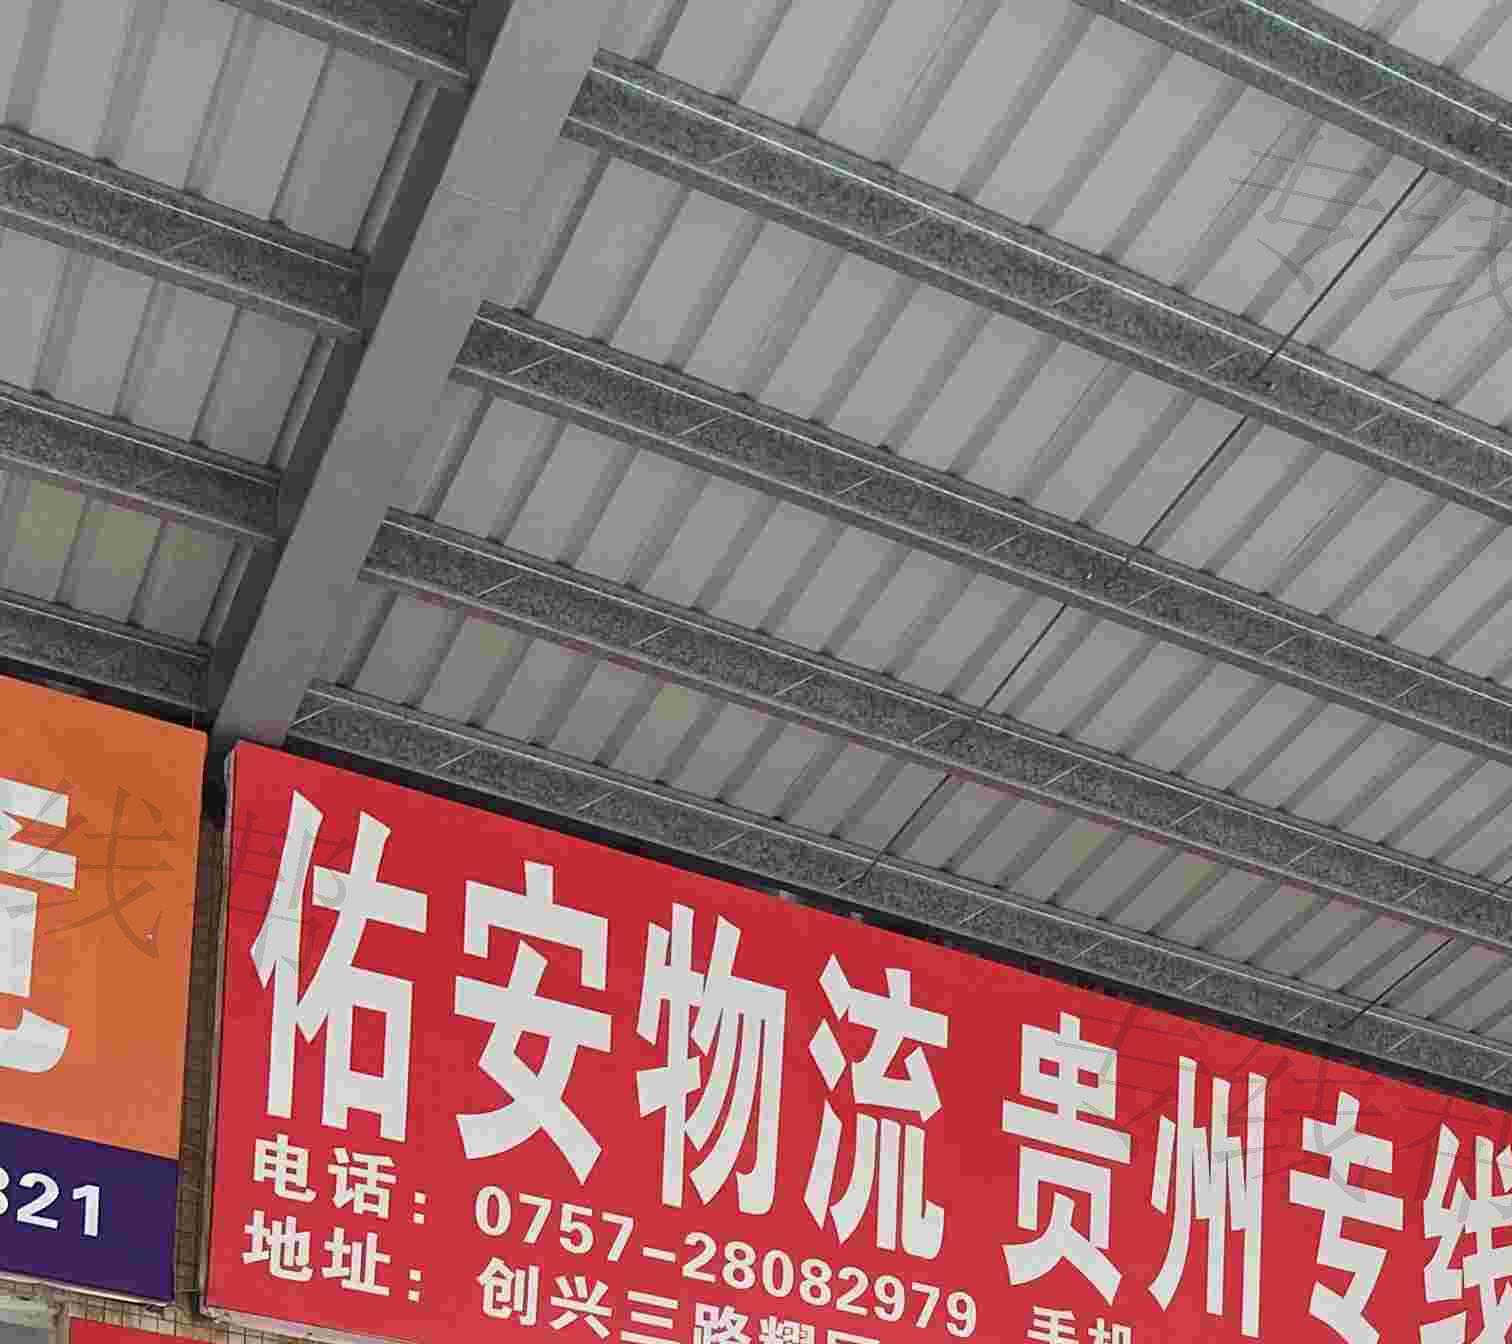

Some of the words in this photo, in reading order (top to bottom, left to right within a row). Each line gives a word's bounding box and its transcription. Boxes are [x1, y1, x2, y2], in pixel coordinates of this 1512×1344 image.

[250, 790, 948, 1259] 佑安物流
[0, 1165, 101, 1238] 21
